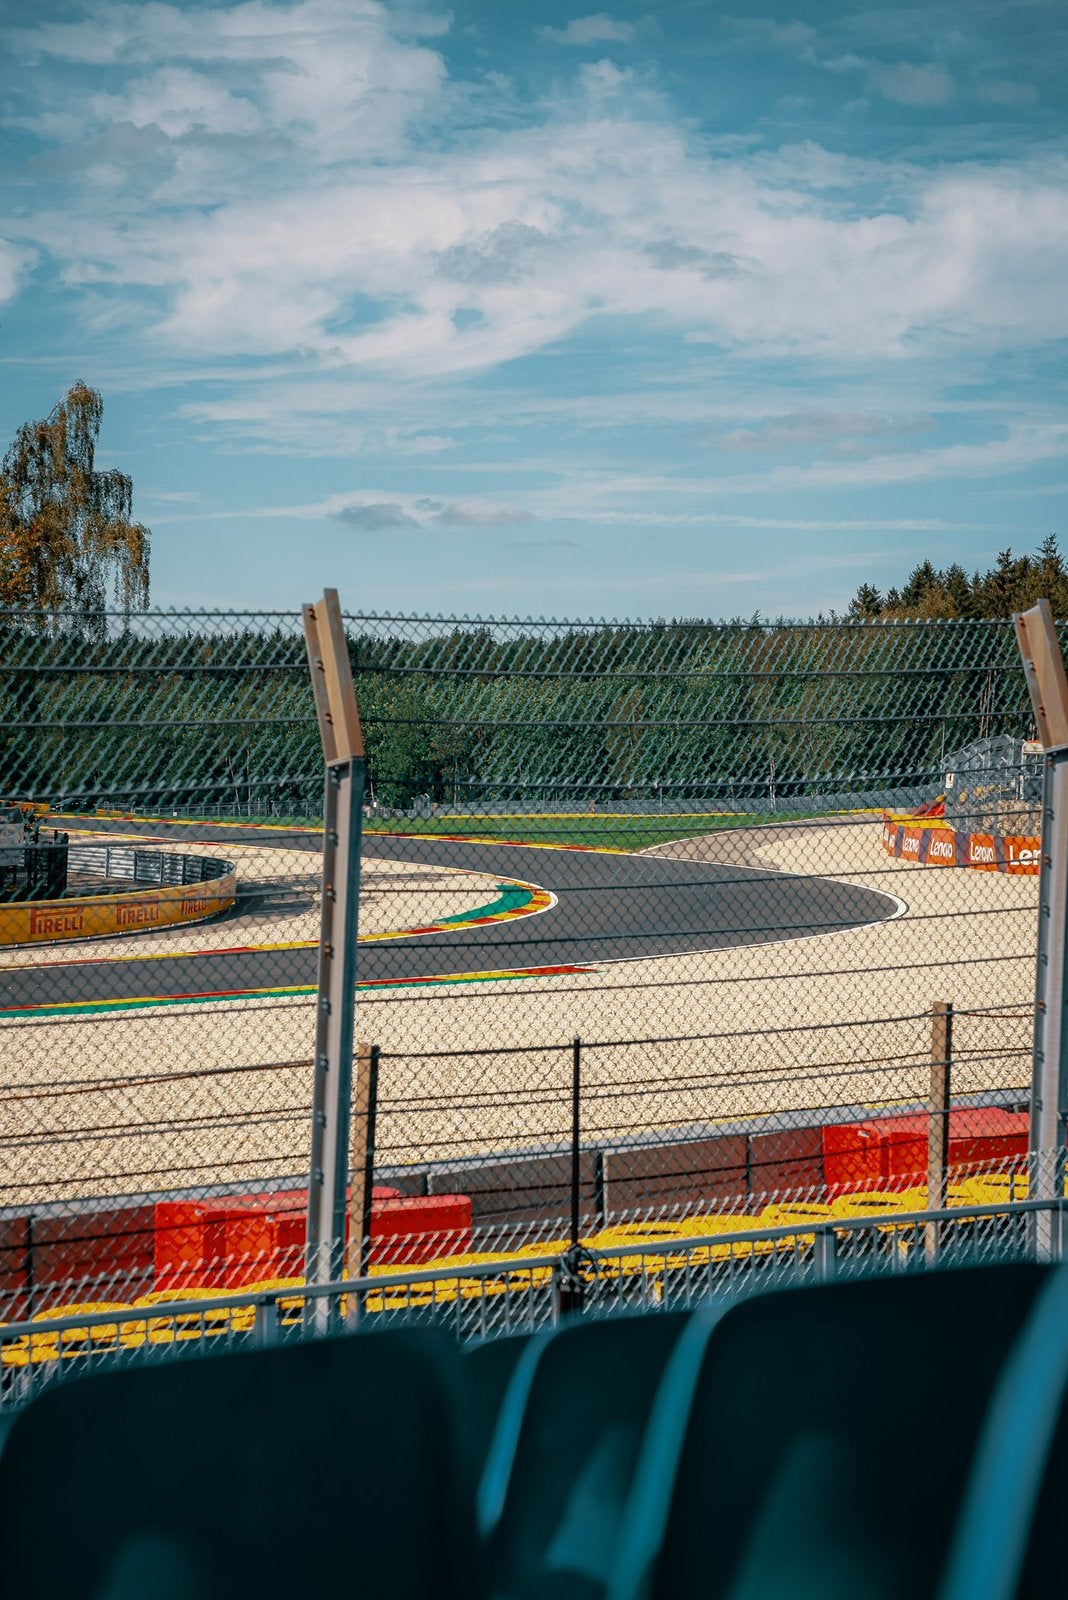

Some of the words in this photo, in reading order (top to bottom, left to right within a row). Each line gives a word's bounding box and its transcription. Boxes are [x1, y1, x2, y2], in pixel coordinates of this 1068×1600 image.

[929, 838, 953, 858] Lenovo
[970, 842, 994, 862] Lenovo
[30, 904, 85, 935] PIRELLI
[116, 895, 159, 925] PIRELLI
